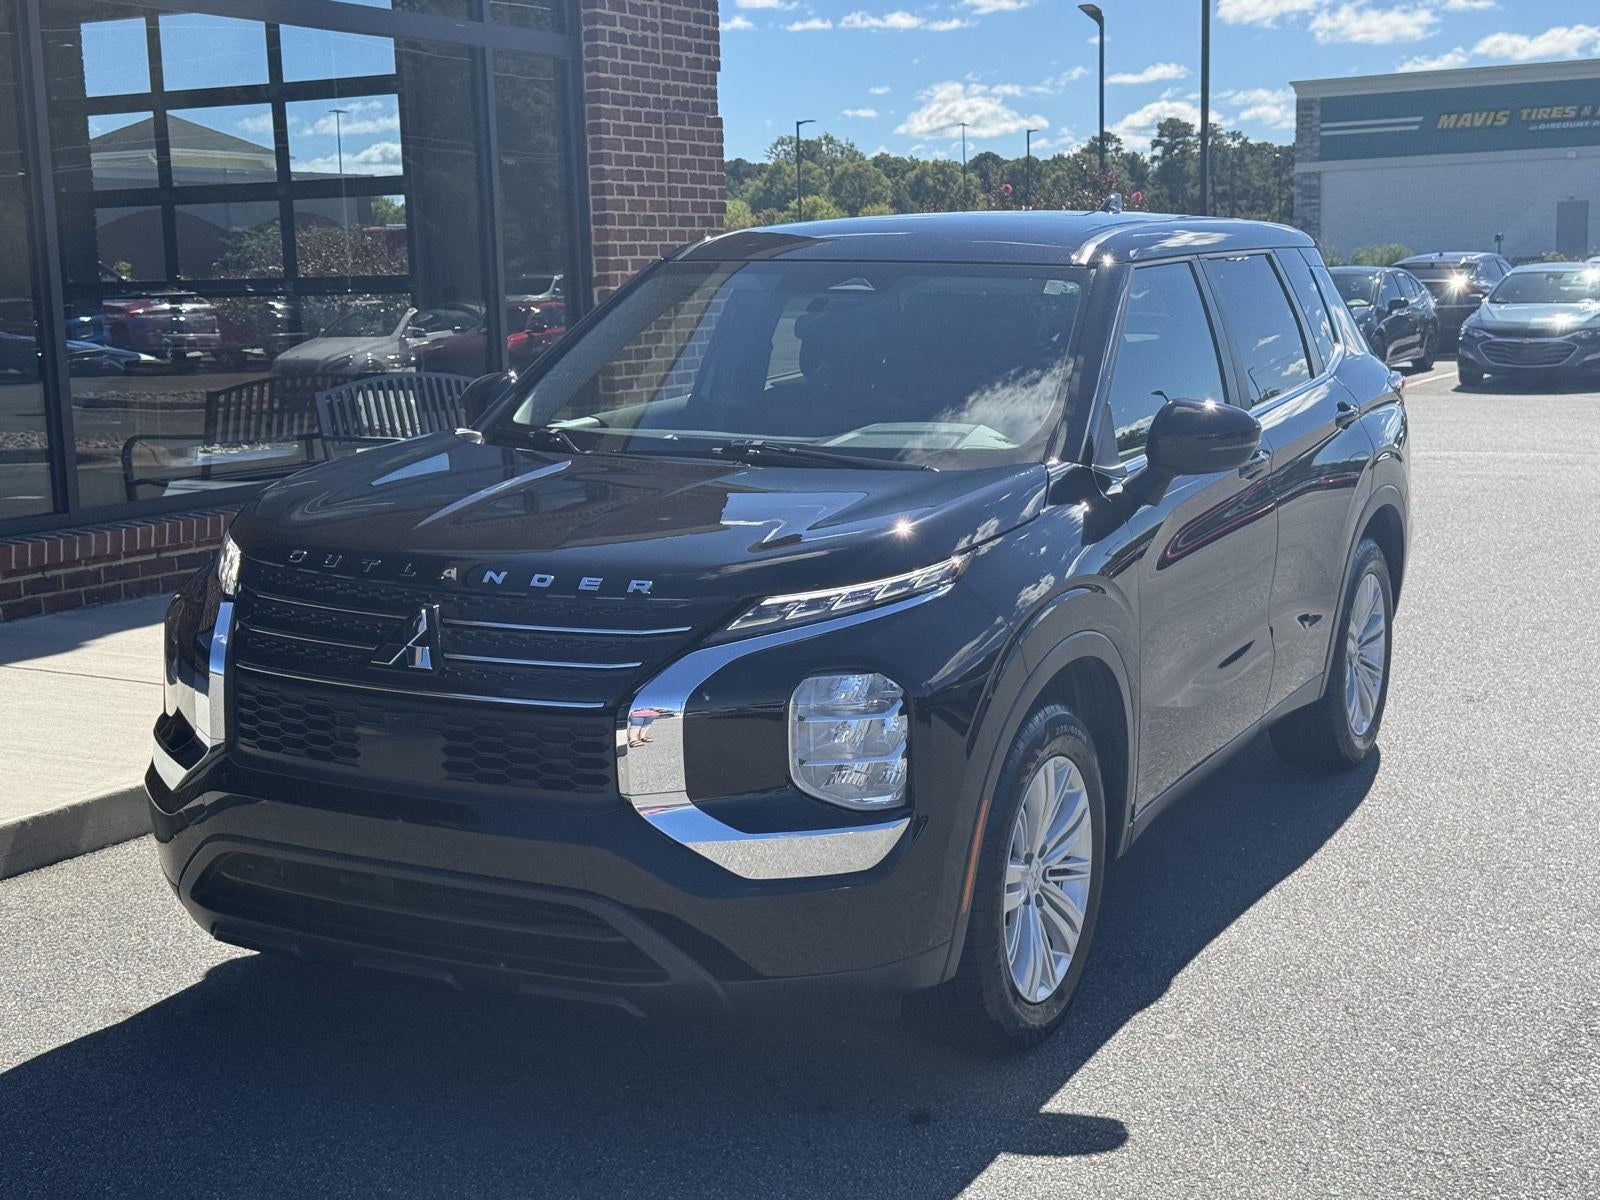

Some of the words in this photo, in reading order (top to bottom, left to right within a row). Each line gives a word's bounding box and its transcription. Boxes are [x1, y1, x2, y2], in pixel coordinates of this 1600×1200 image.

[1436, 110, 1510, 129] MAVIS
[1520, 105, 1577, 120] TIRES
[1580, 105, 1592, 116] &
[1538, 120, 1590, 130] DISCOUNT
[289, 549, 654, 595] OUTLANDER
